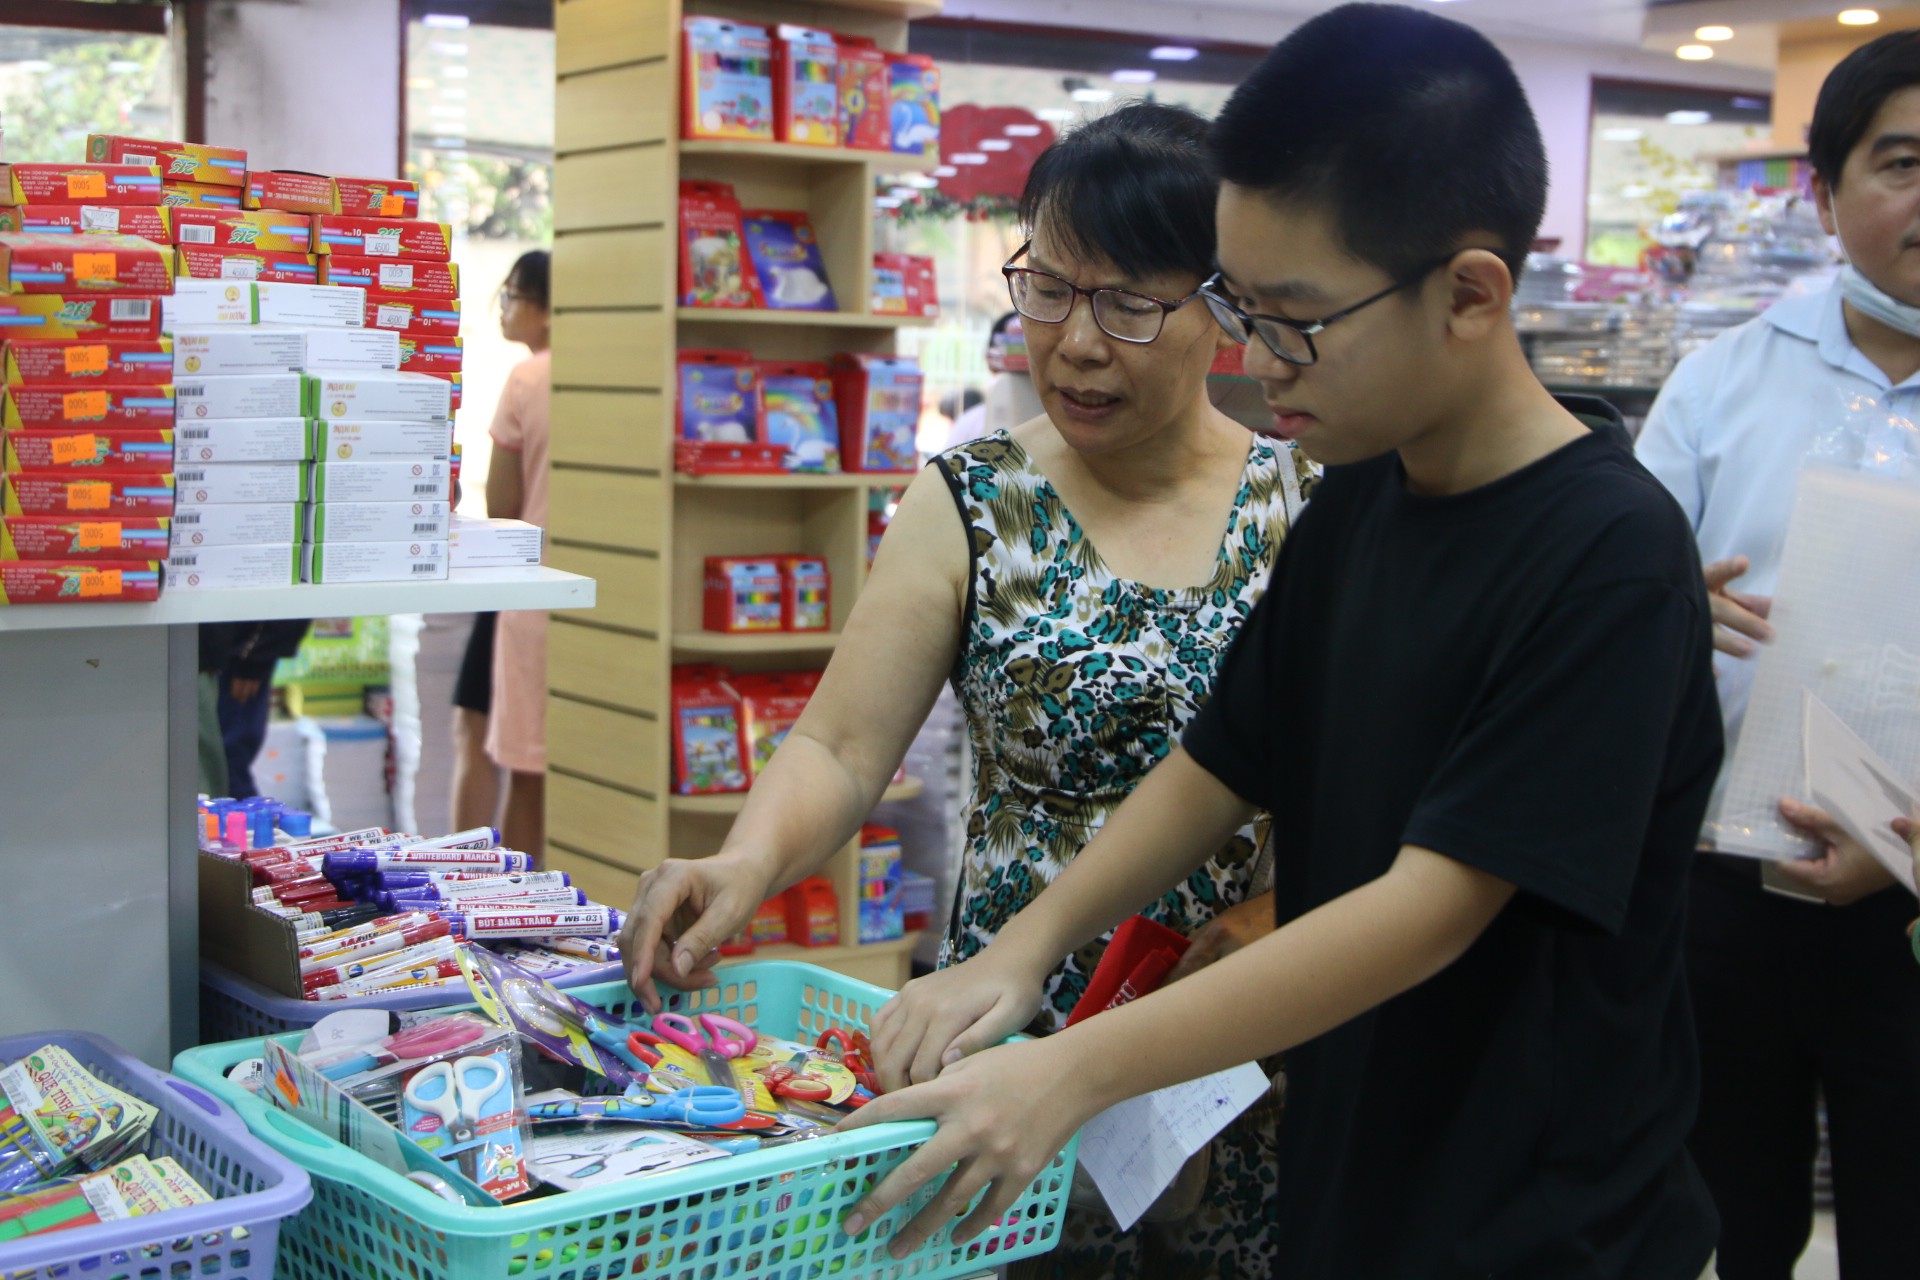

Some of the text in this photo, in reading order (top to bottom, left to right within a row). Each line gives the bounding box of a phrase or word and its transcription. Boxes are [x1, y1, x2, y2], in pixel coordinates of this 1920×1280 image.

[168, 159, 197, 174] 215
[73, 181, 89, 190] 5000
[117, 185, 127, 193] 10
[60, 217, 70, 225] 10
[228, 229, 257, 244] 215
[374, 243, 389, 251] 4500
[52, 263, 63, 271] 10
[92, 263, 111, 274] 5000
[361, 268, 370, 276] 10
[59, 301, 96, 320] 215
[70, 352, 89, 362] 5000
[67, 399, 88, 409] 5000
[57, 442, 76, 454] 5000
[72, 489, 92, 500] 5000
[84, 528, 104, 538] 5000
[85, 576, 104, 586] 5000
[412, 853, 496, 861] WHITEBOARD MARKER
[478, 915, 552, 928] BÚT BẢNG TRẮNG
[39, 1071, 74, 1113] QUE TÍNH
[127, 1182, 147, 1201] QUE
